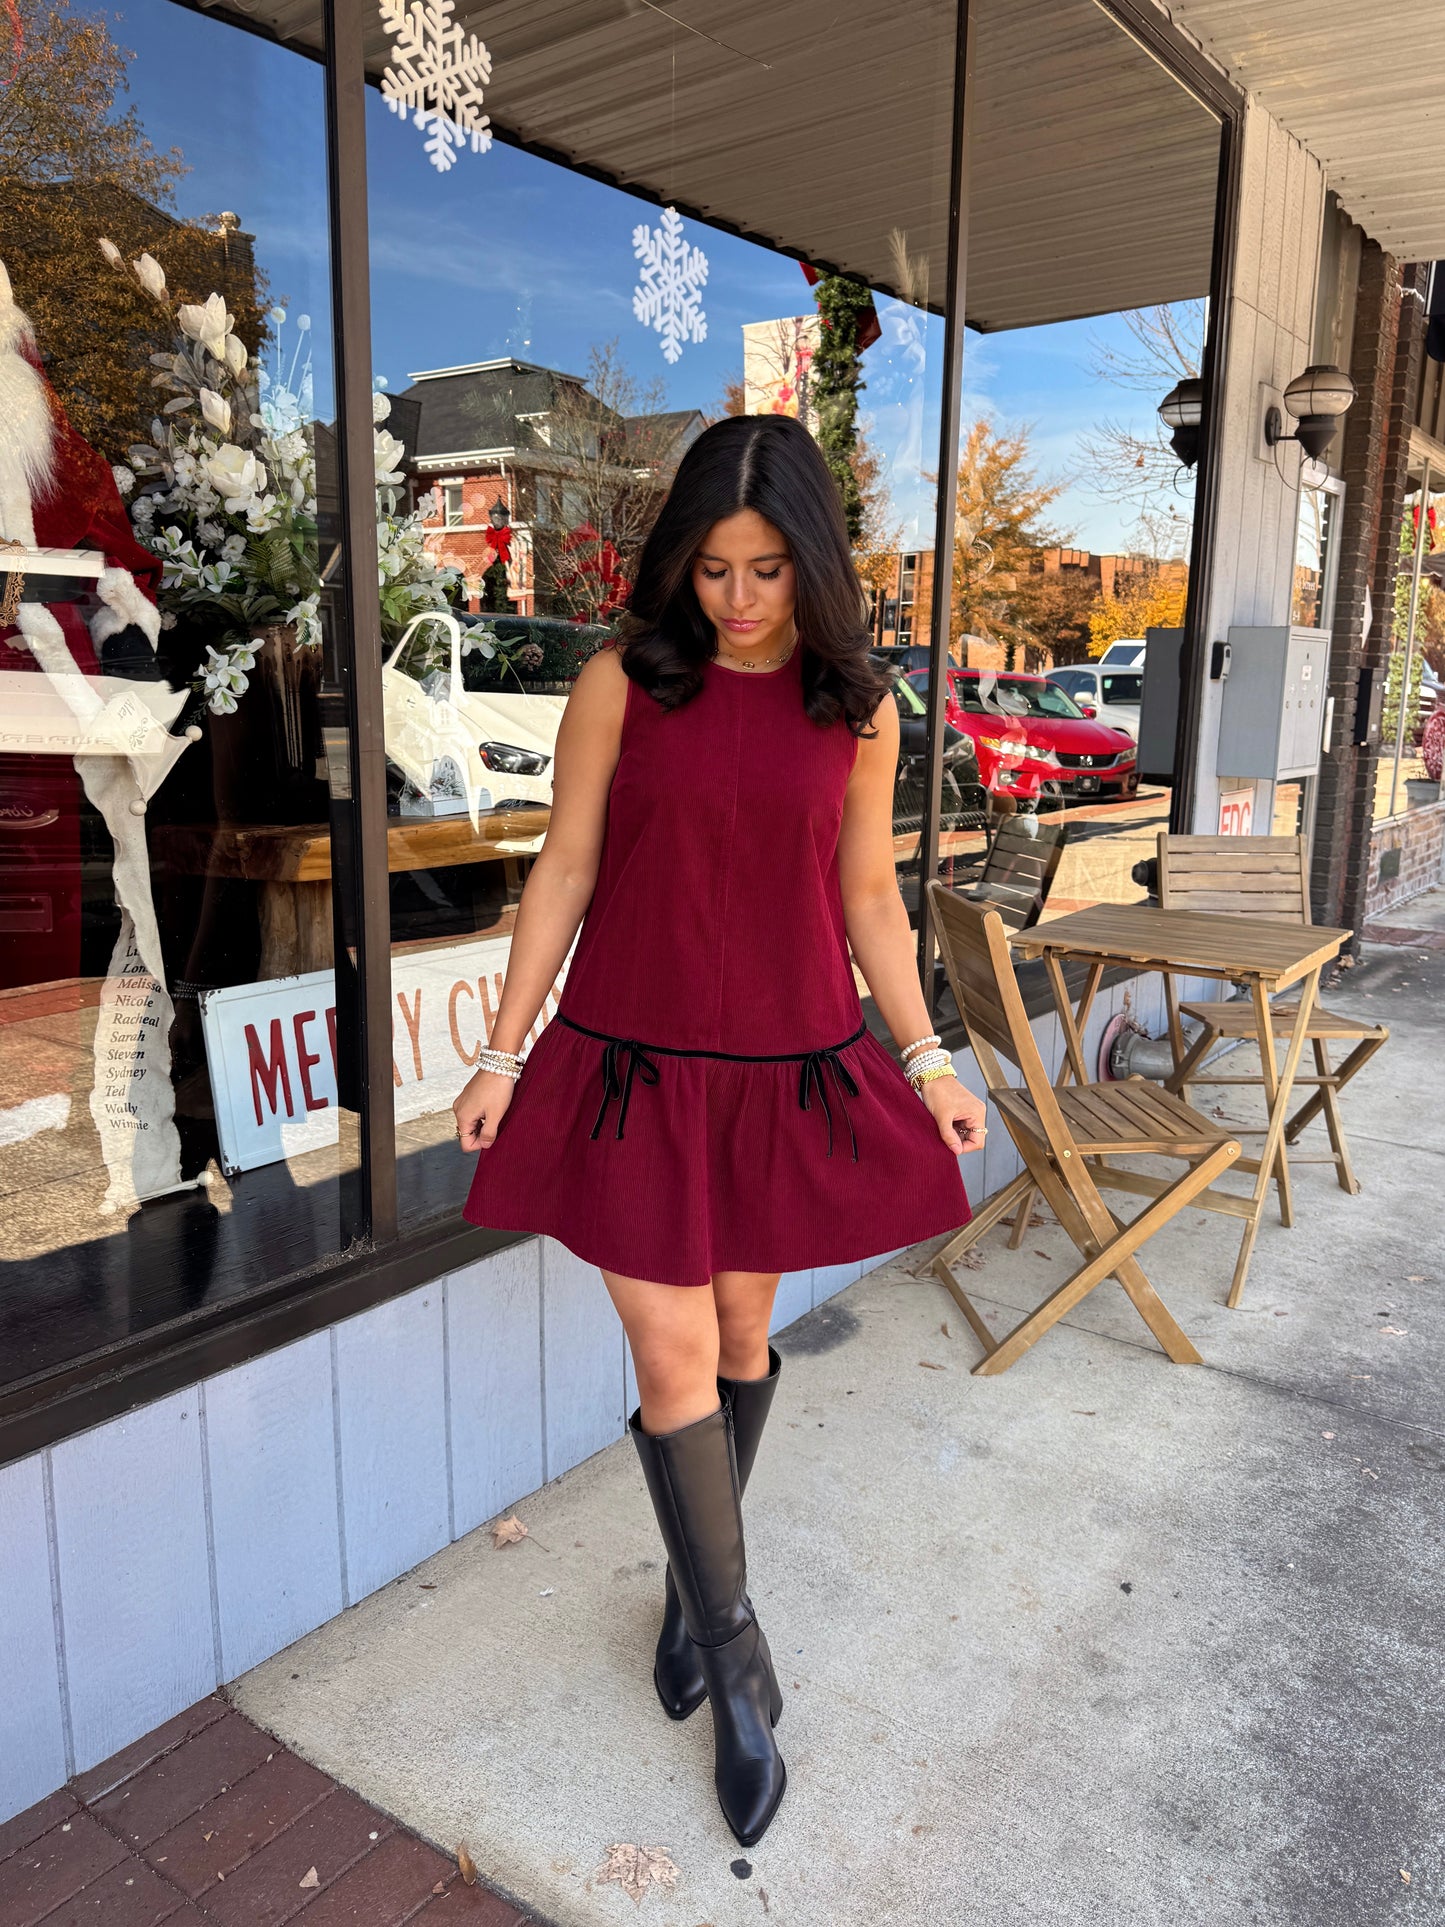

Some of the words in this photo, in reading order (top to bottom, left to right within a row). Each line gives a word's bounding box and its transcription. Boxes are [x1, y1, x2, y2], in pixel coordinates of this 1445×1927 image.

[121, 963, 148, 974] Lon
[116, 978, 162, 994] Melissa
[114, 994, 154, 1008] Nicole
[112, 1012, 160, 1028] Racheal
[110, 1030, 146, 1043] Sarah
[107, 1048, 145, 1060] Steven
[106, 1066, 147, 1082] Sydney
[104, 1084, 127, 1097] Ted
[104, 1102, 138, 1115] Wally
[109, 1119, 149, 1130] Winnie
